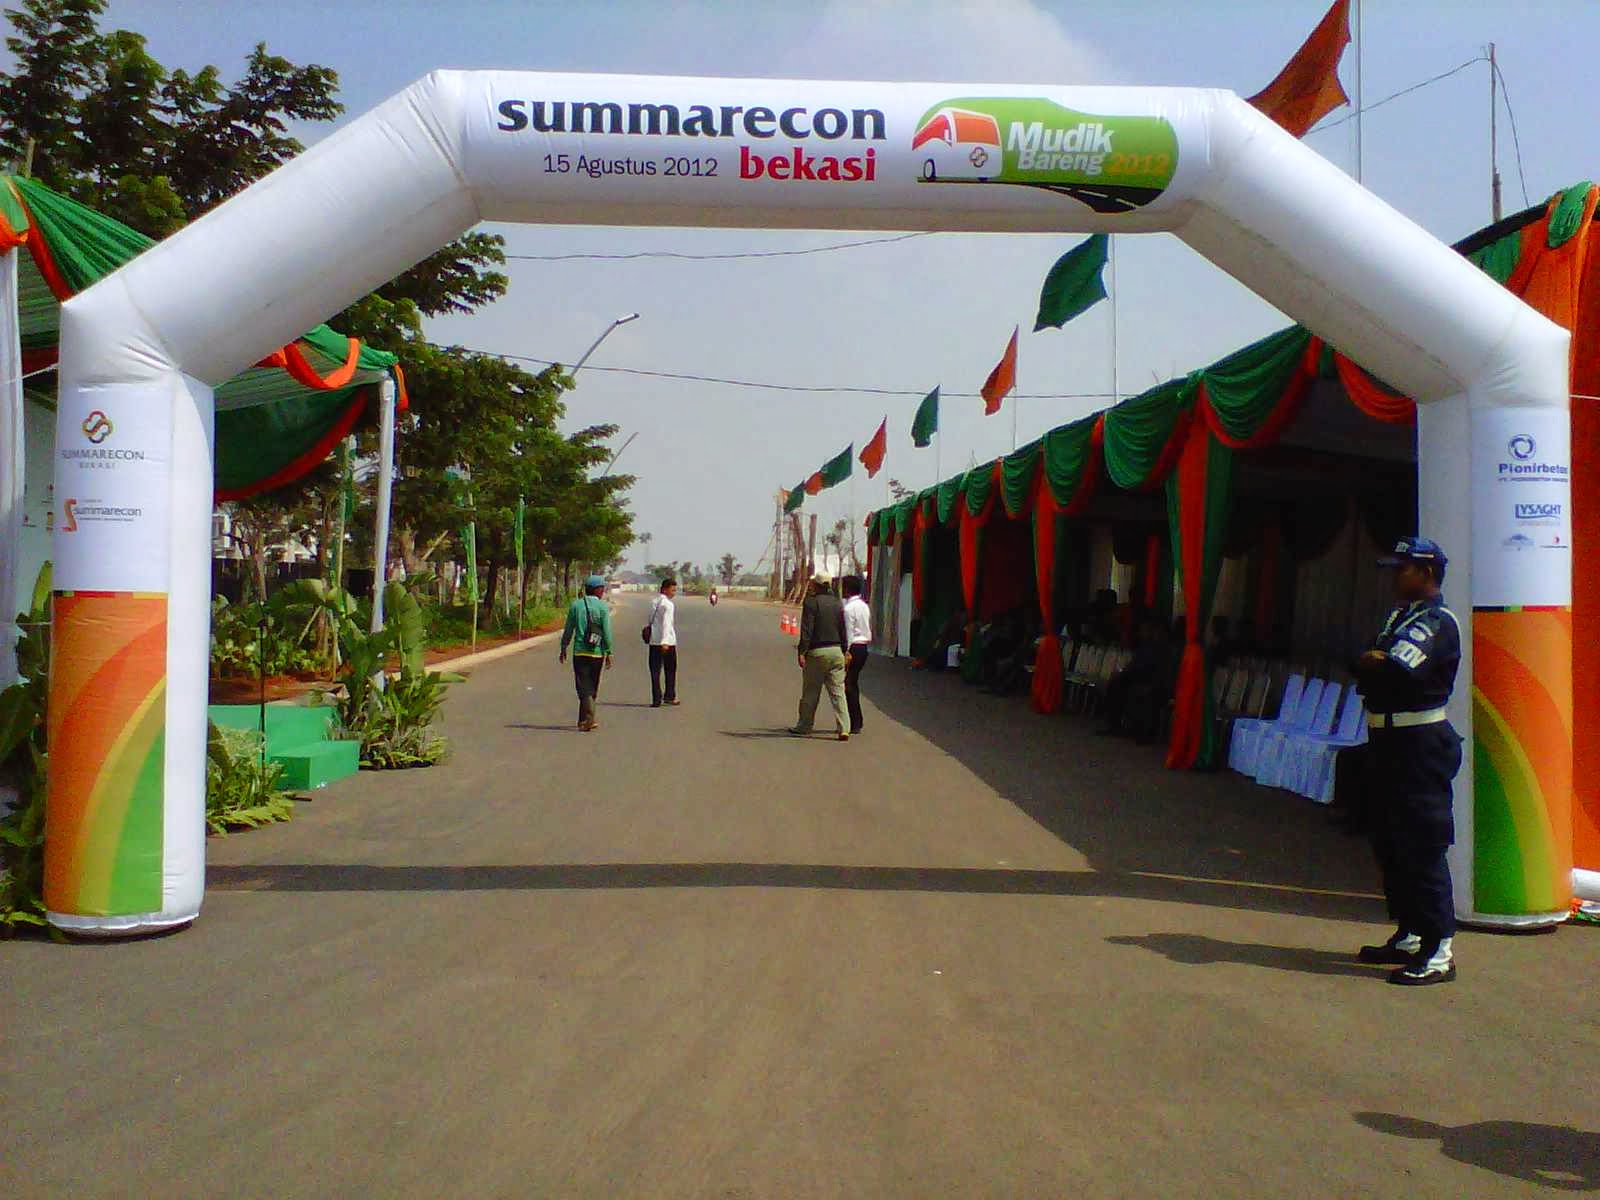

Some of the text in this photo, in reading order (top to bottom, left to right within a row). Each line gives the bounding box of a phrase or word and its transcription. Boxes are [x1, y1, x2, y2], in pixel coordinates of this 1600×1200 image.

[498, 99, 887, 141] summarecon
[1007, 121, 1114, 153] Mudik
[543, 154, 718, 178] 15 Agustus 2012
[738, 145, 877, 182] bekasi
[1018, 149, 1169, 175] Bareng 2012
[1515, 504, 1561, 519] LYSAGHT
